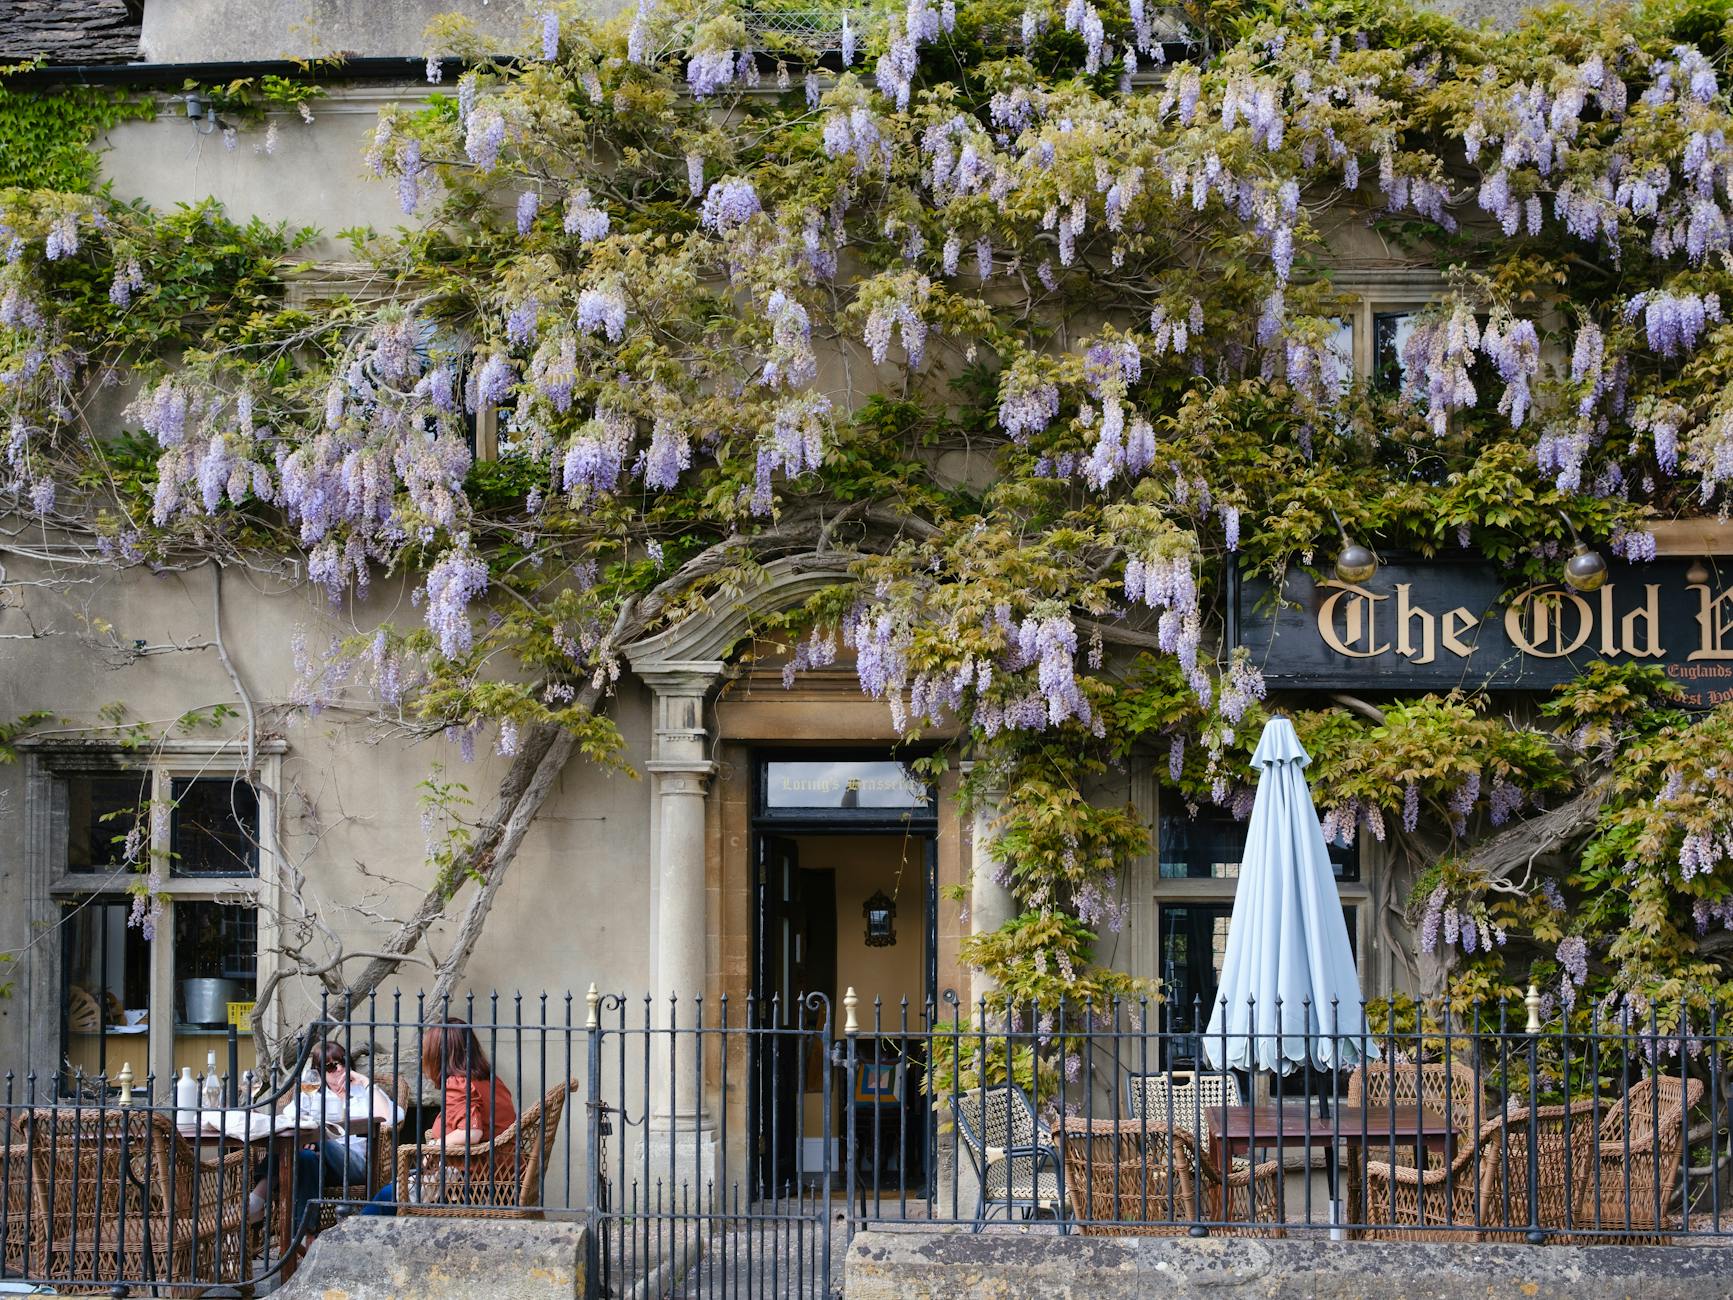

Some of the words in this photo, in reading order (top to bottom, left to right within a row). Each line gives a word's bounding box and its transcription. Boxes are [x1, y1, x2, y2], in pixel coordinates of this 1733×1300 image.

[1315, 579, 1479, 664] The
[1504, 583, 1667, 658] Old
[1667, 663, 1732, 680] Englands
[783, 776, 840, 792] Loring's
